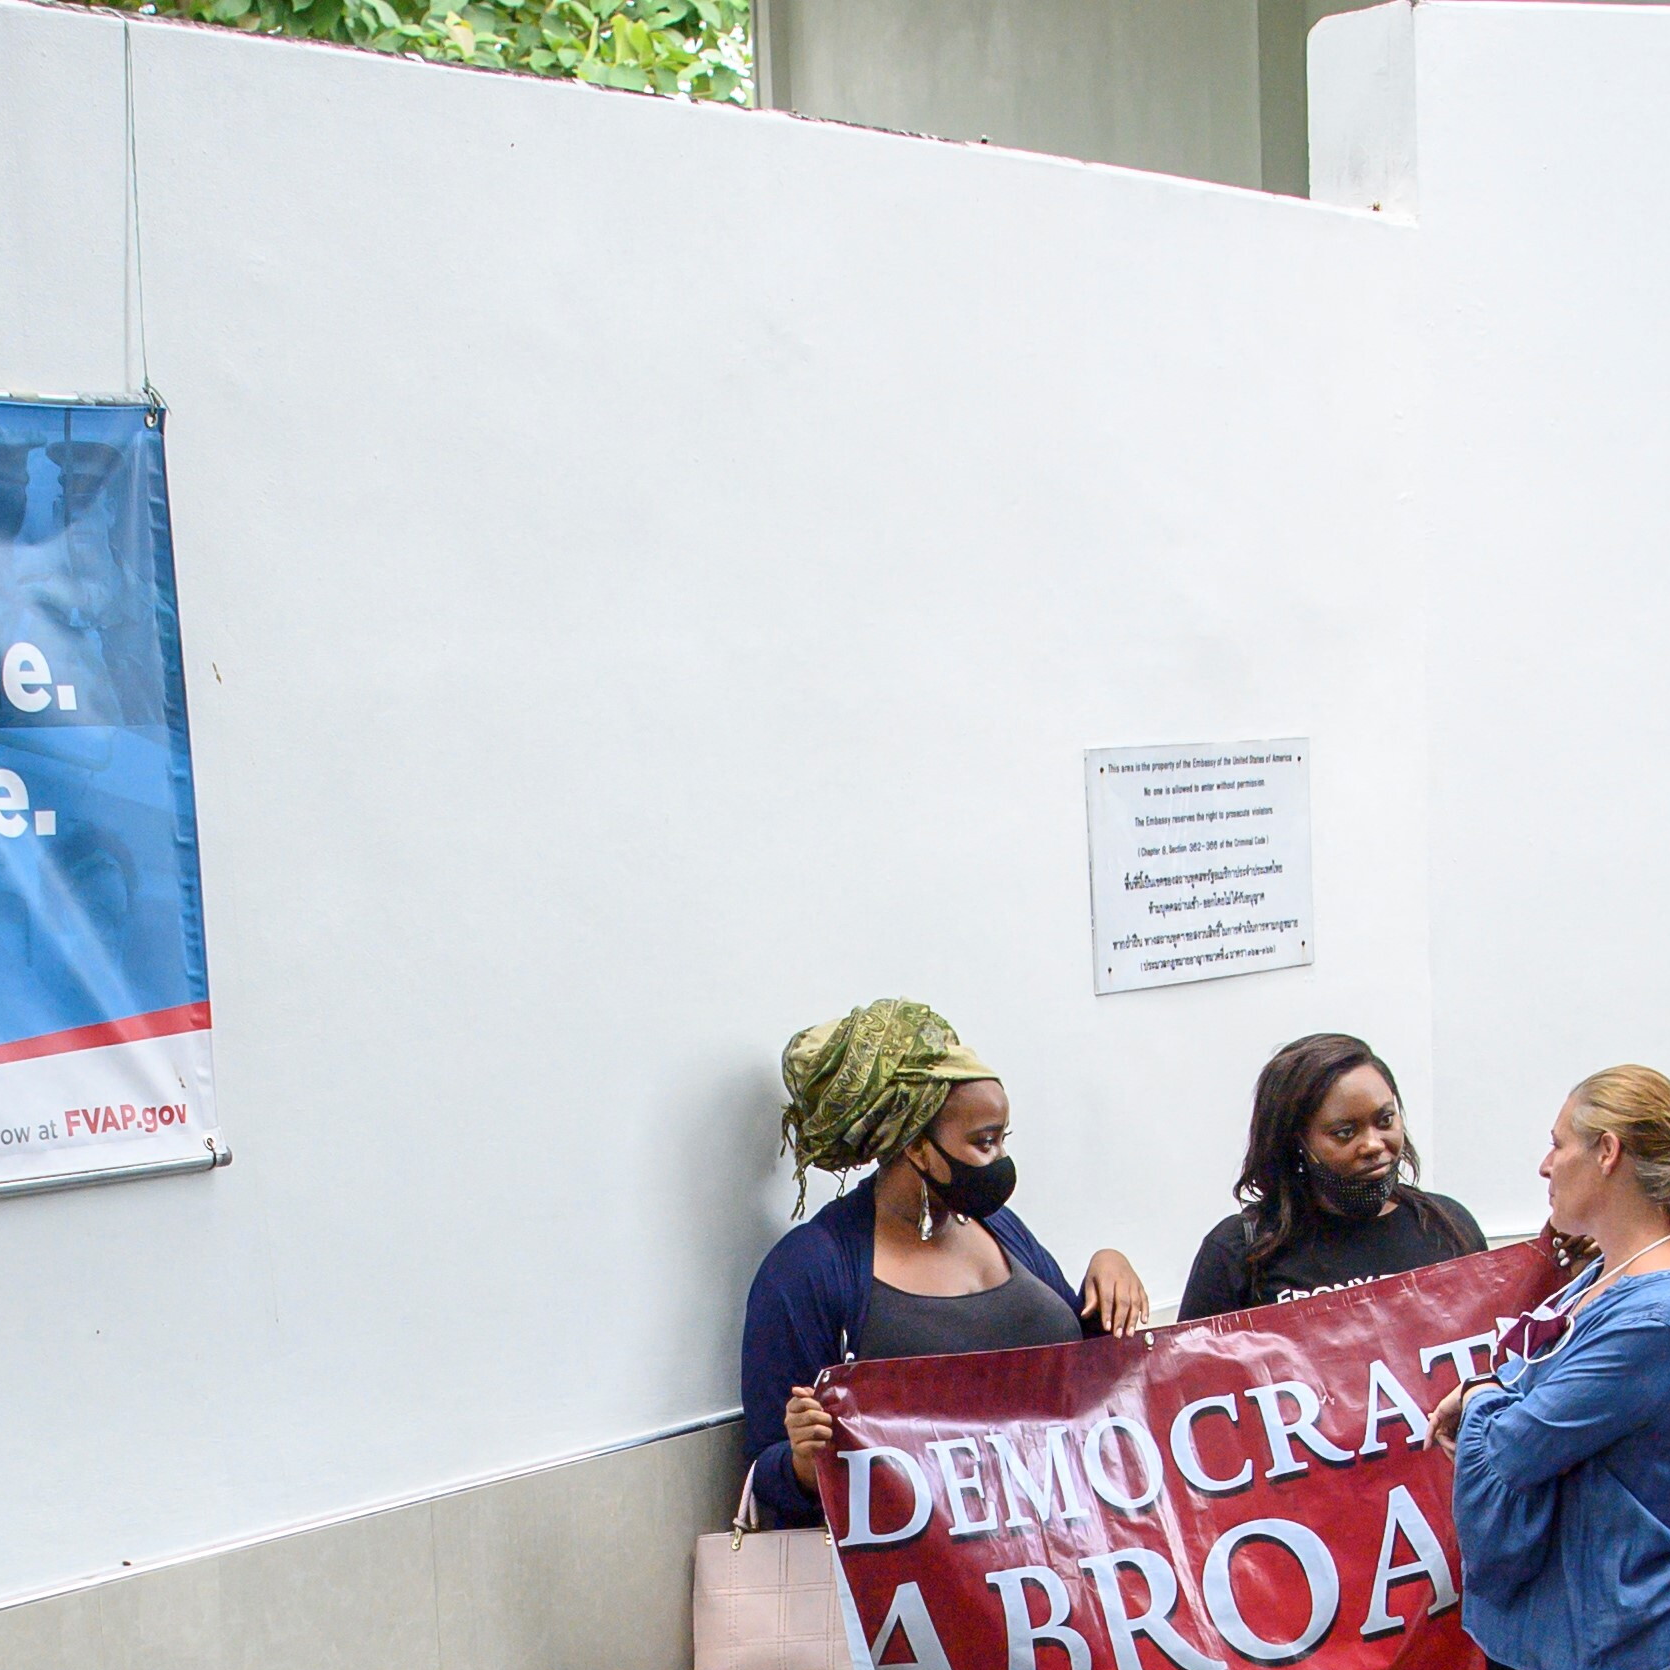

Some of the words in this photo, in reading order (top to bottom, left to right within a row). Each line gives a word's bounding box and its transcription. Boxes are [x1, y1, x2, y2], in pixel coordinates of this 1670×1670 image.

[38, 1119, 58, 1140] at
[64, 1103, 187, 1137] FVAP.gov
[837, 1318, 1524, 1549] DEMOCRAT
